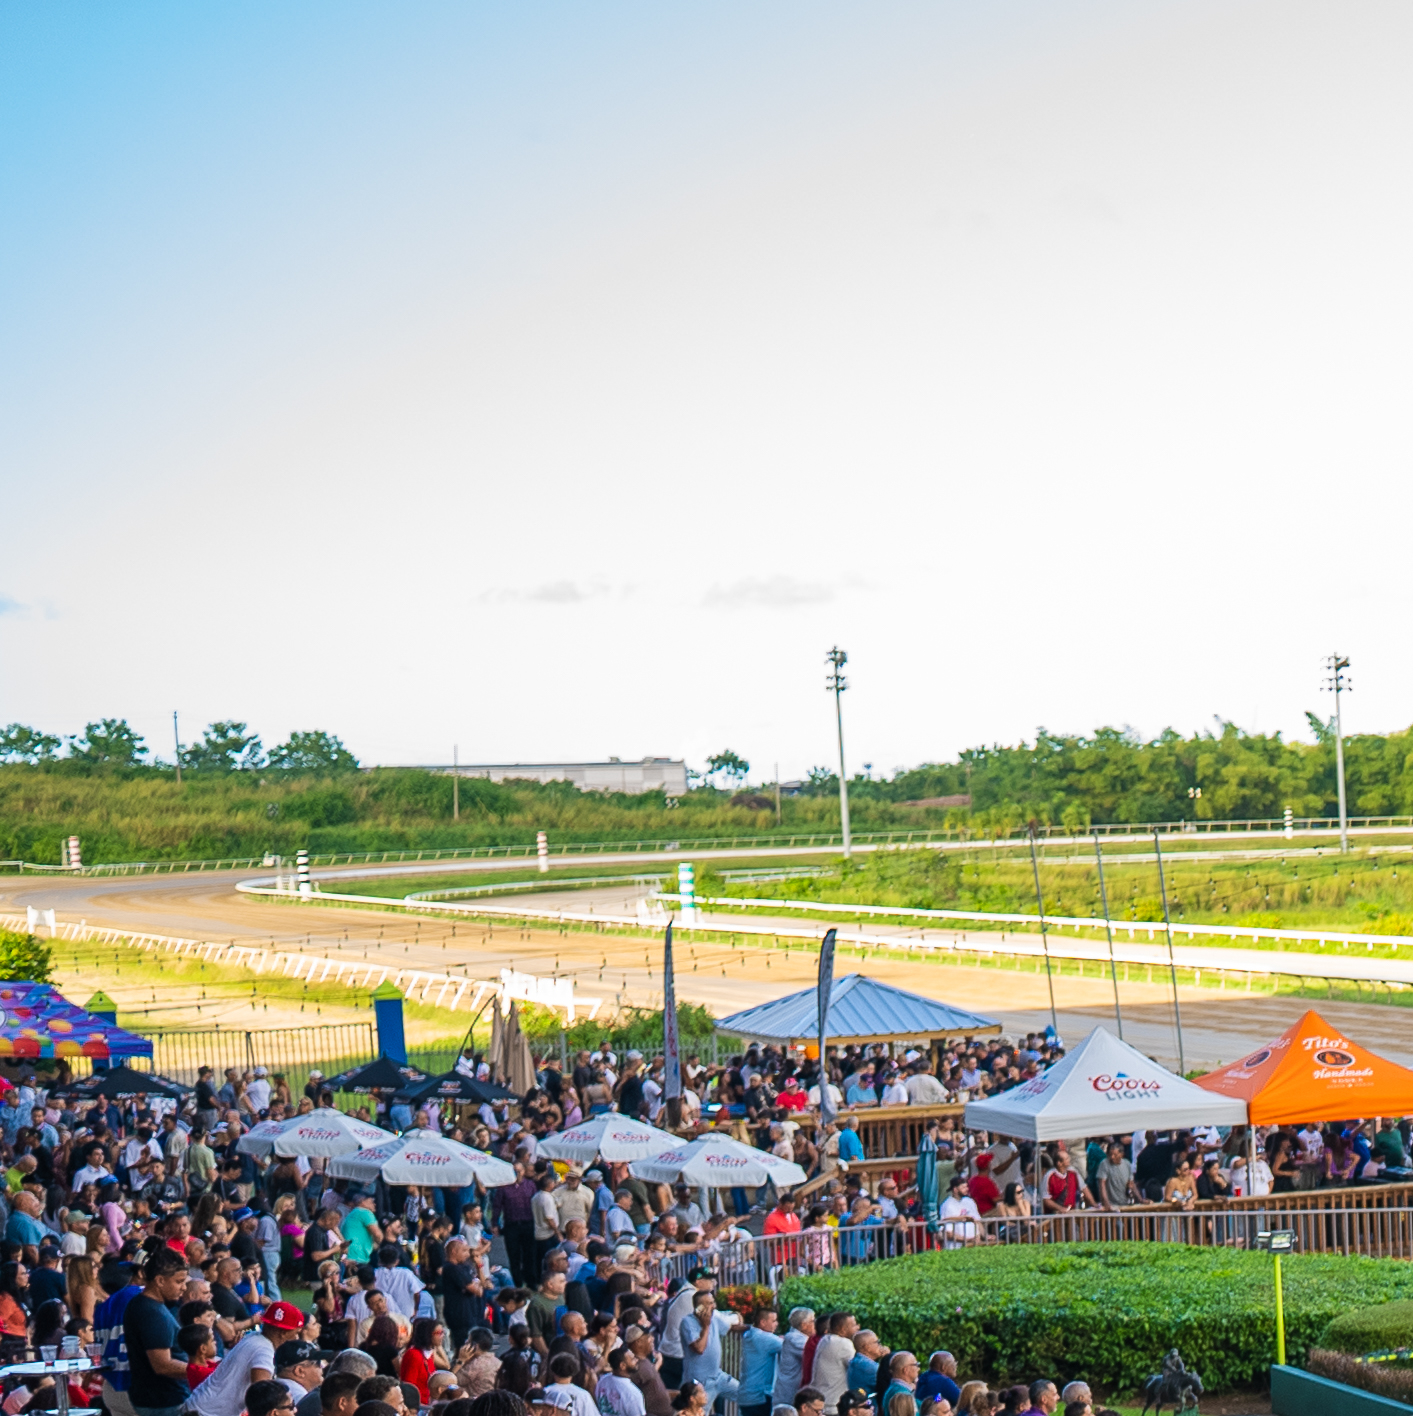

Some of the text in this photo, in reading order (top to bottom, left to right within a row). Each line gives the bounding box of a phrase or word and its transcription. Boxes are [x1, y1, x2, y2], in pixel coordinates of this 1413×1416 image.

[1302, 1036, 1350, 1050] Tito's
[1313, 1068, 1374, 1079] Handmade
[1088, 1075, 1163, 1092] Coors
[1106, 1089, 1160, 1101] LIGHT
